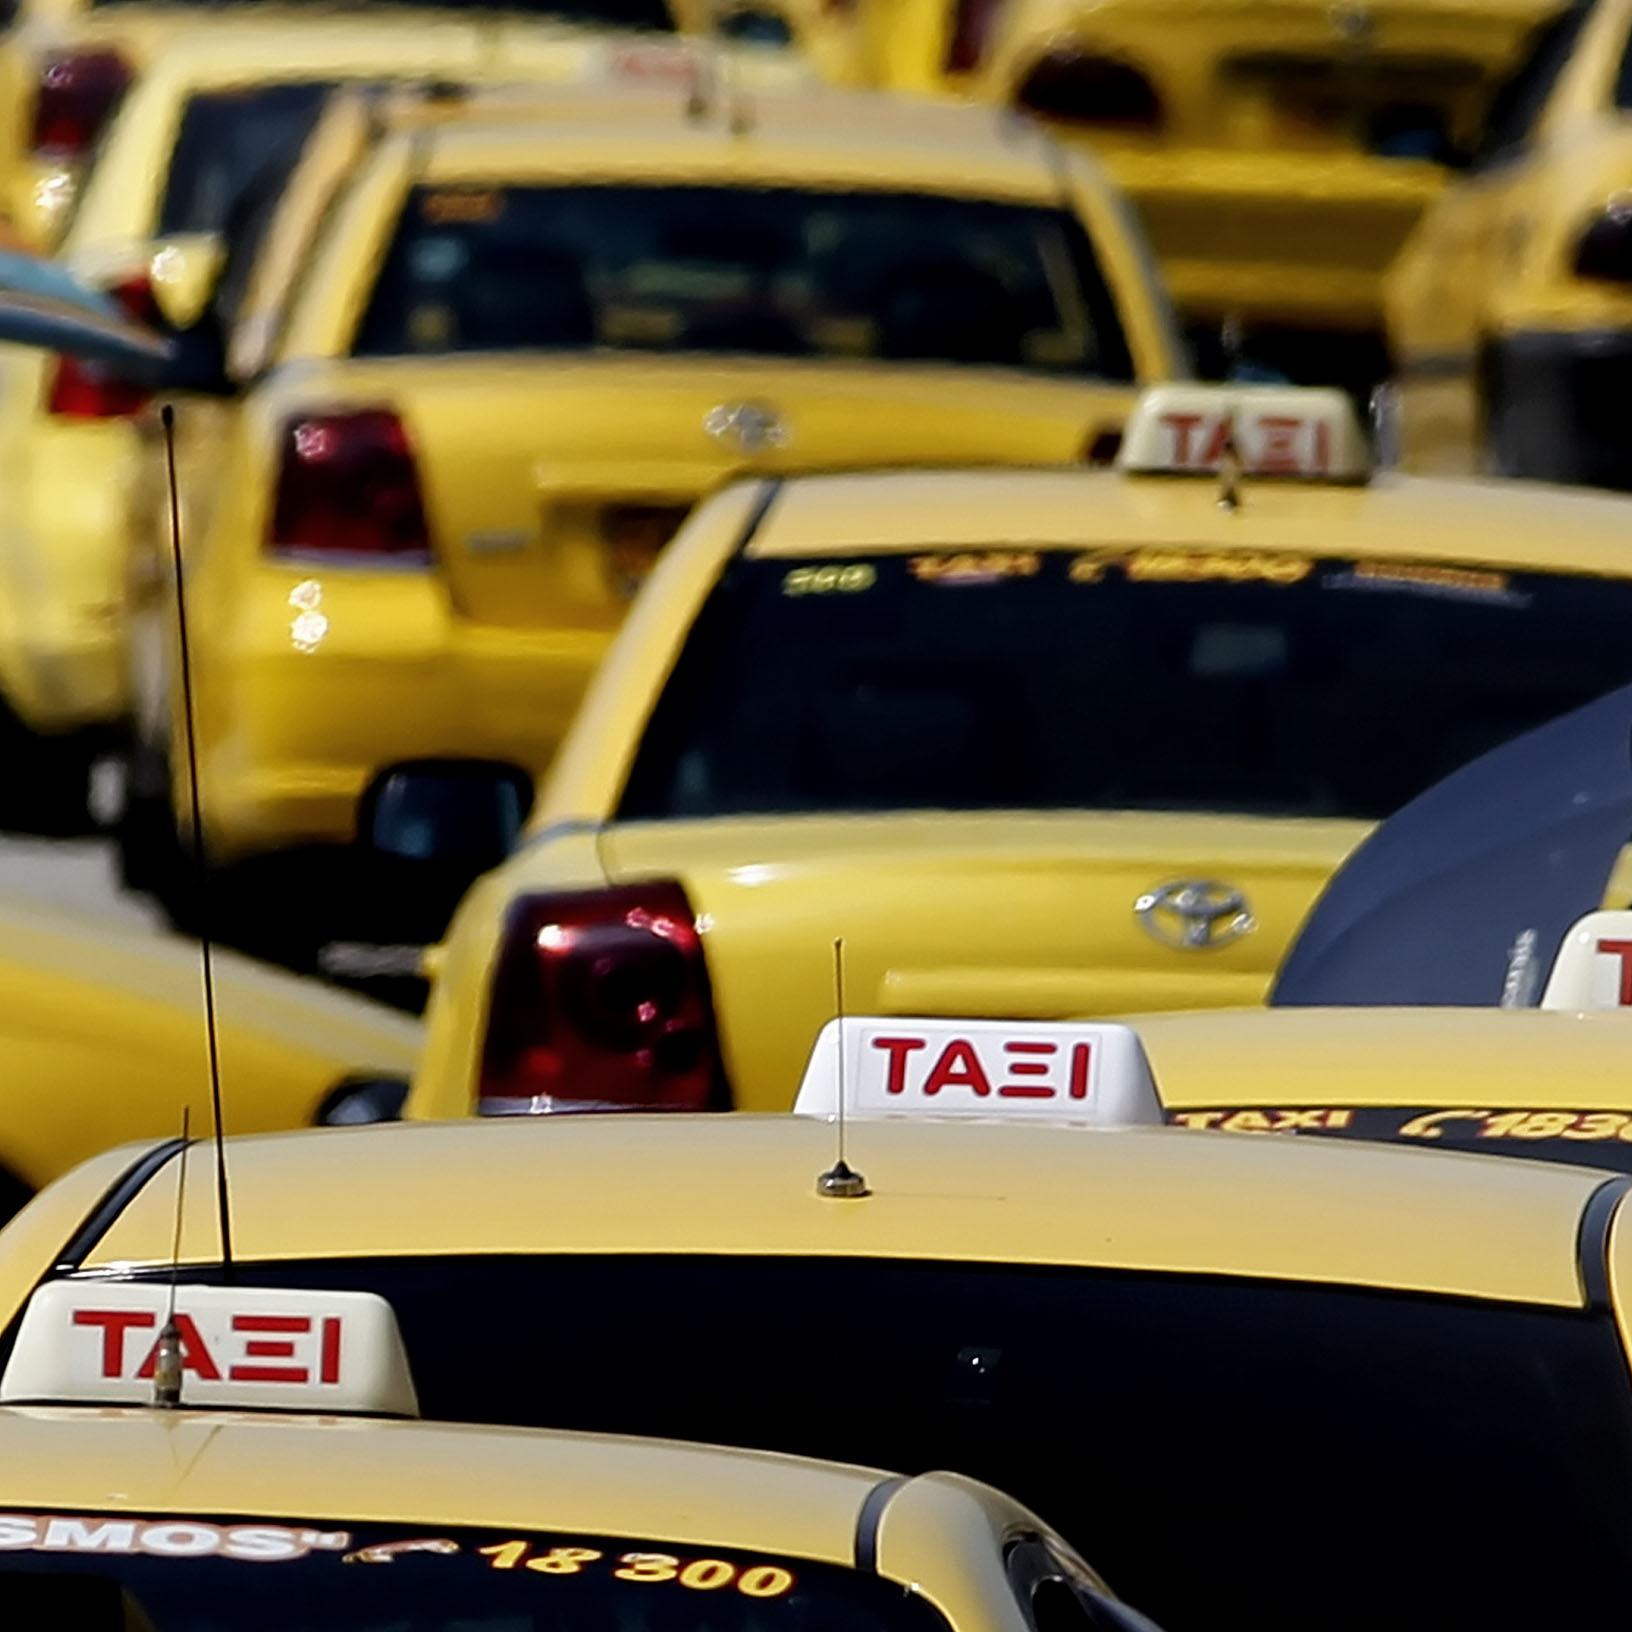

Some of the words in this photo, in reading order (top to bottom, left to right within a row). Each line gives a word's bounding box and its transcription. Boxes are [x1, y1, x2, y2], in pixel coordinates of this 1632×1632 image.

[872, 1037, 1091, 1099] ΤΑΞΙ
[1173, 1108, 1352, 1134] TAXI
[72, 1310, 341, 1384] ΤΑΞΙ
[479, 1541, 602, 1573] 18
[613, 1552, 792, 1597] 300
